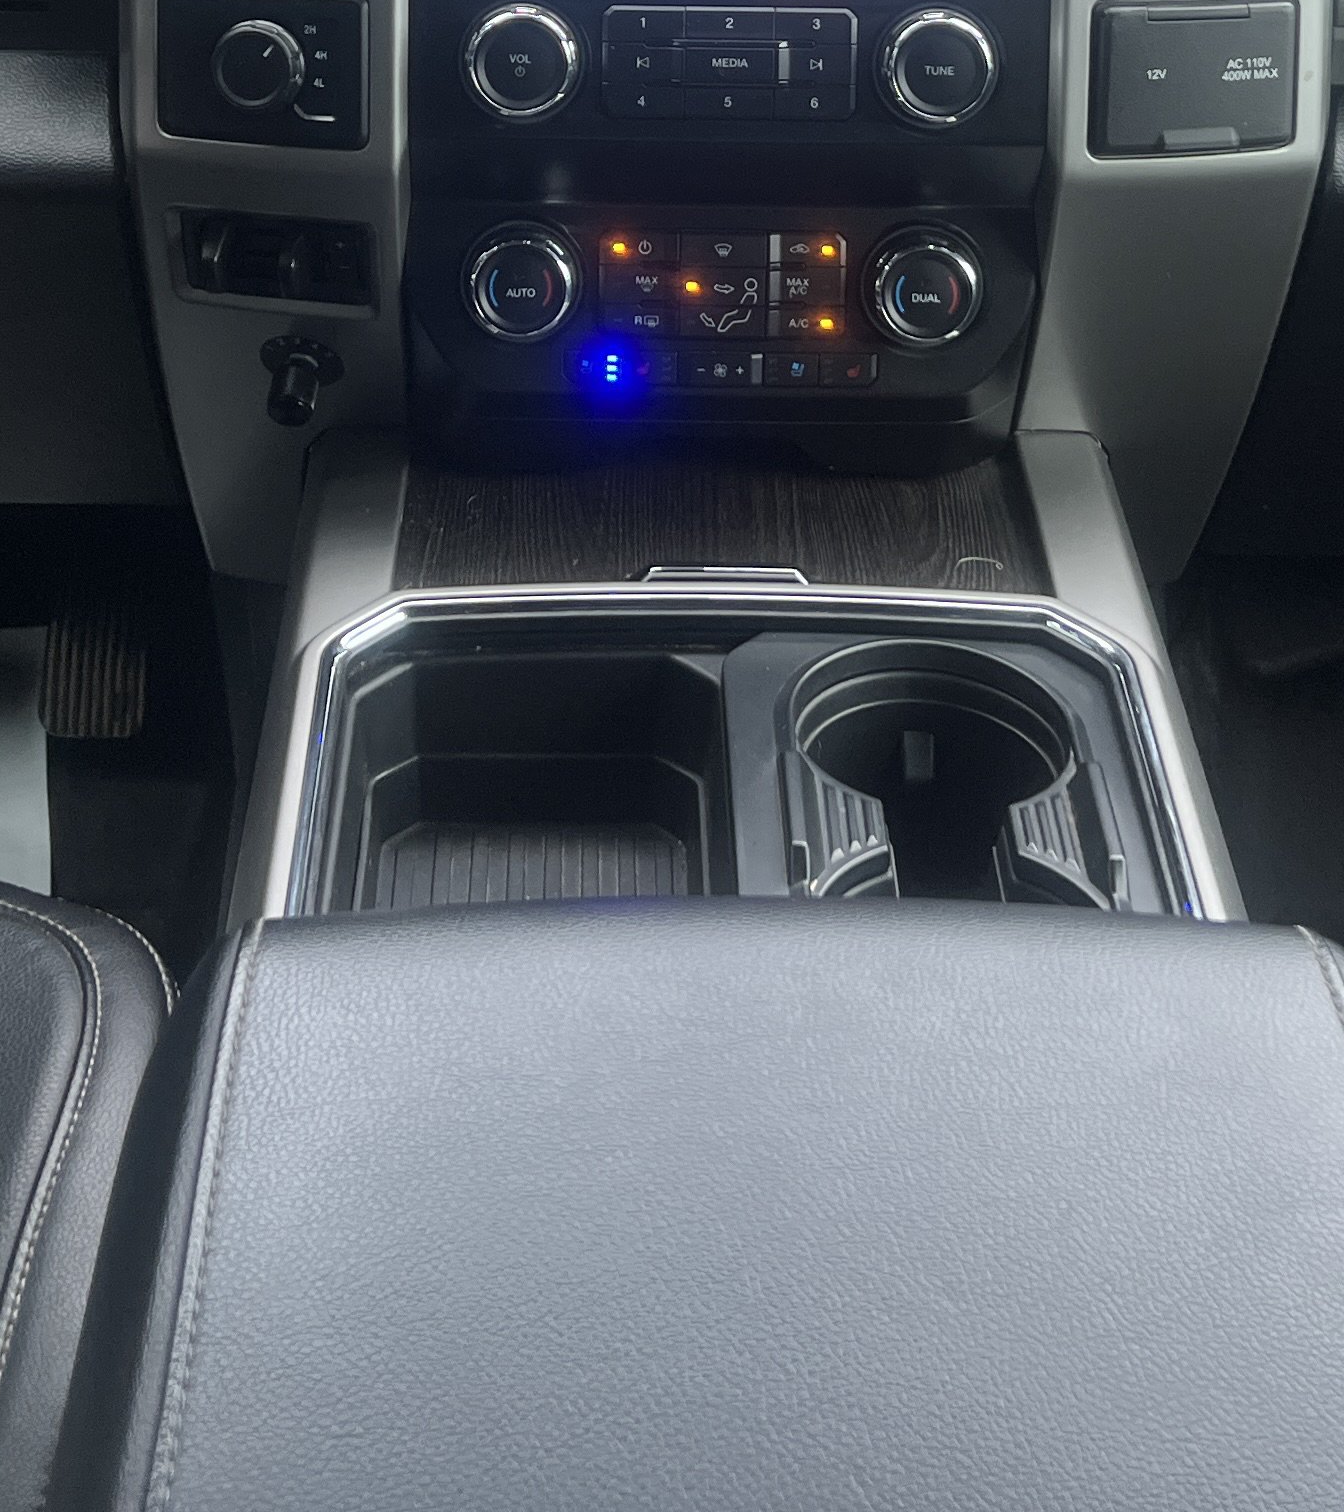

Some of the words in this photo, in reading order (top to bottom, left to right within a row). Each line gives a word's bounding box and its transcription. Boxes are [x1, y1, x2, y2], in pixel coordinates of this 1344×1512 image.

[639, 17, 646, 29] 1
[725, 17, 734, 29] 2
[812, 18, 821, 30] 3
[303, 24, 317, 35] 2H
[314, 50, 328, 61] 4H
[509, 53, 531, 64] VOL
[711, 57, 749, 68] MEDIA
[1226, 58, 1244, 70] AC
[1245, 56, 1273, 68] 110V
[924, 65, 955, 76] TUNE
[1145, 68, 1168, 80] 12V
[1221, 69, 1252, 81] 400W
[1253, 67, 1279, 80] MAX
[313, 77, 325, 88] 4L
[637, 95, 646, 107] 4
[723, 96, 732, 108] 5
[810, 97, 819, 109] 6
[635, 275, 659, 285] MAX
[786, 277, 810, 287] MAX
[505, 287, 536, 299] AUTO
[789, 286, 807, 296] A/C
[911, 292, 942, 304] DUAL
[634, 315, 643, 326] R
[788, 318, 809, 329] A/C
